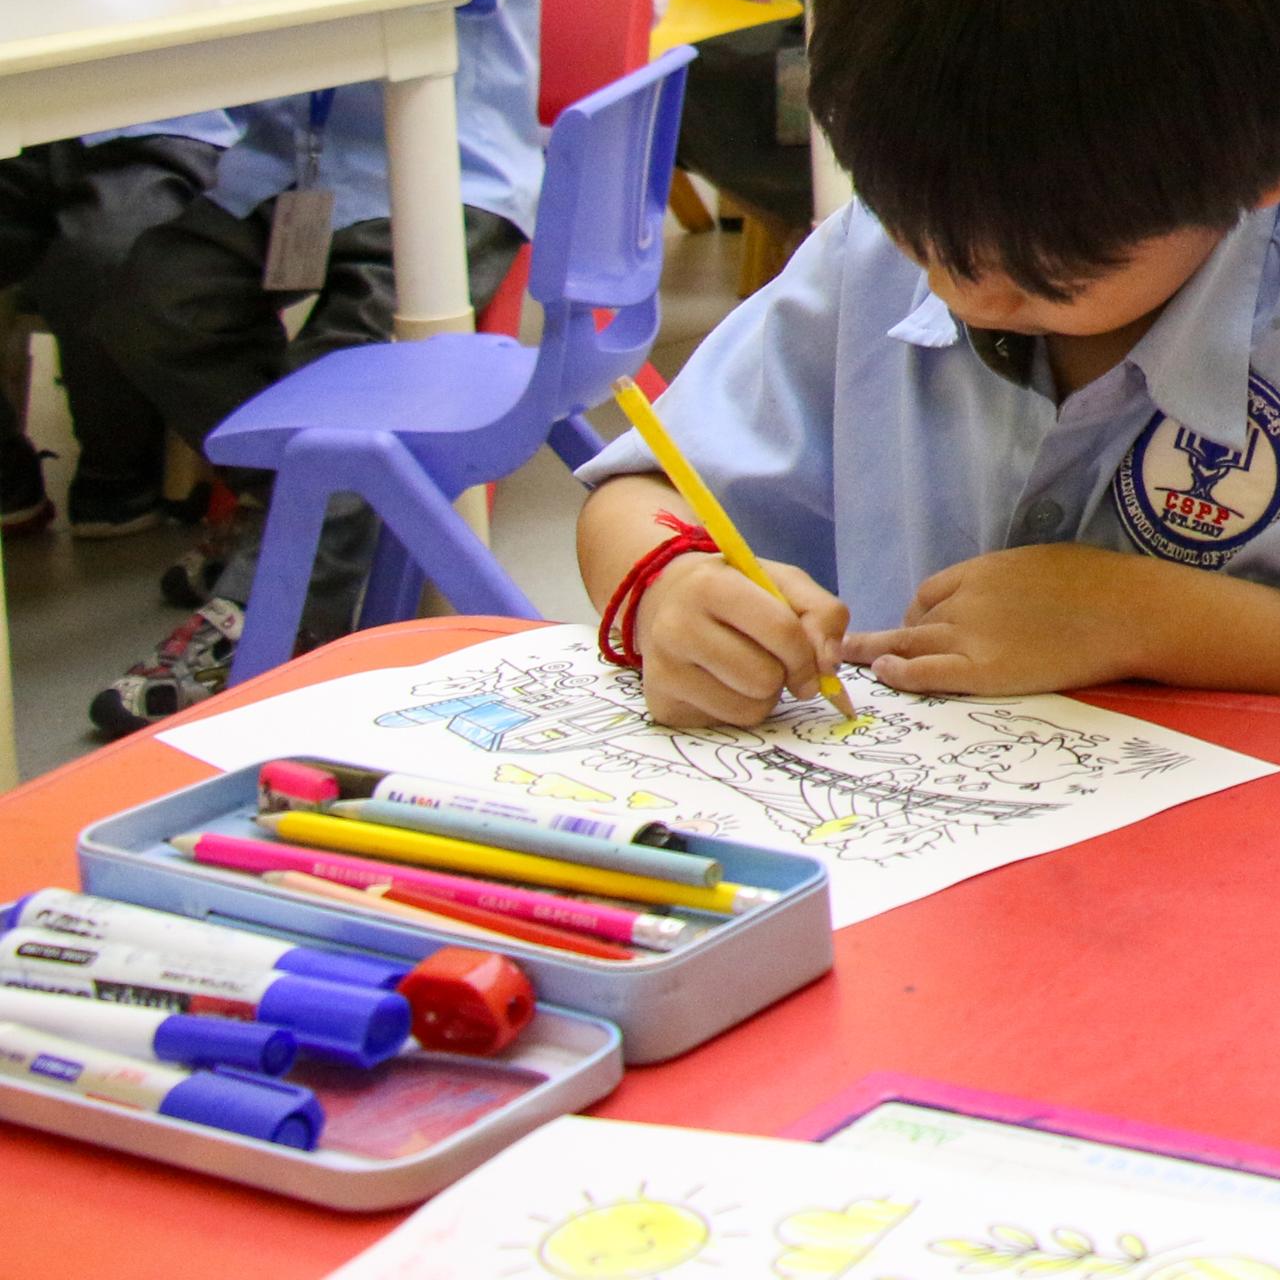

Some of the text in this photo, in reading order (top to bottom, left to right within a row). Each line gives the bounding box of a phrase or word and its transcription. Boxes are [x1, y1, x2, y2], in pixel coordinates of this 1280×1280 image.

[1165, 491, 1230, 526] CSPP
[1152, 533, 1200, 565] SCHOOL
[1200, 549, 1221, 566] OF
